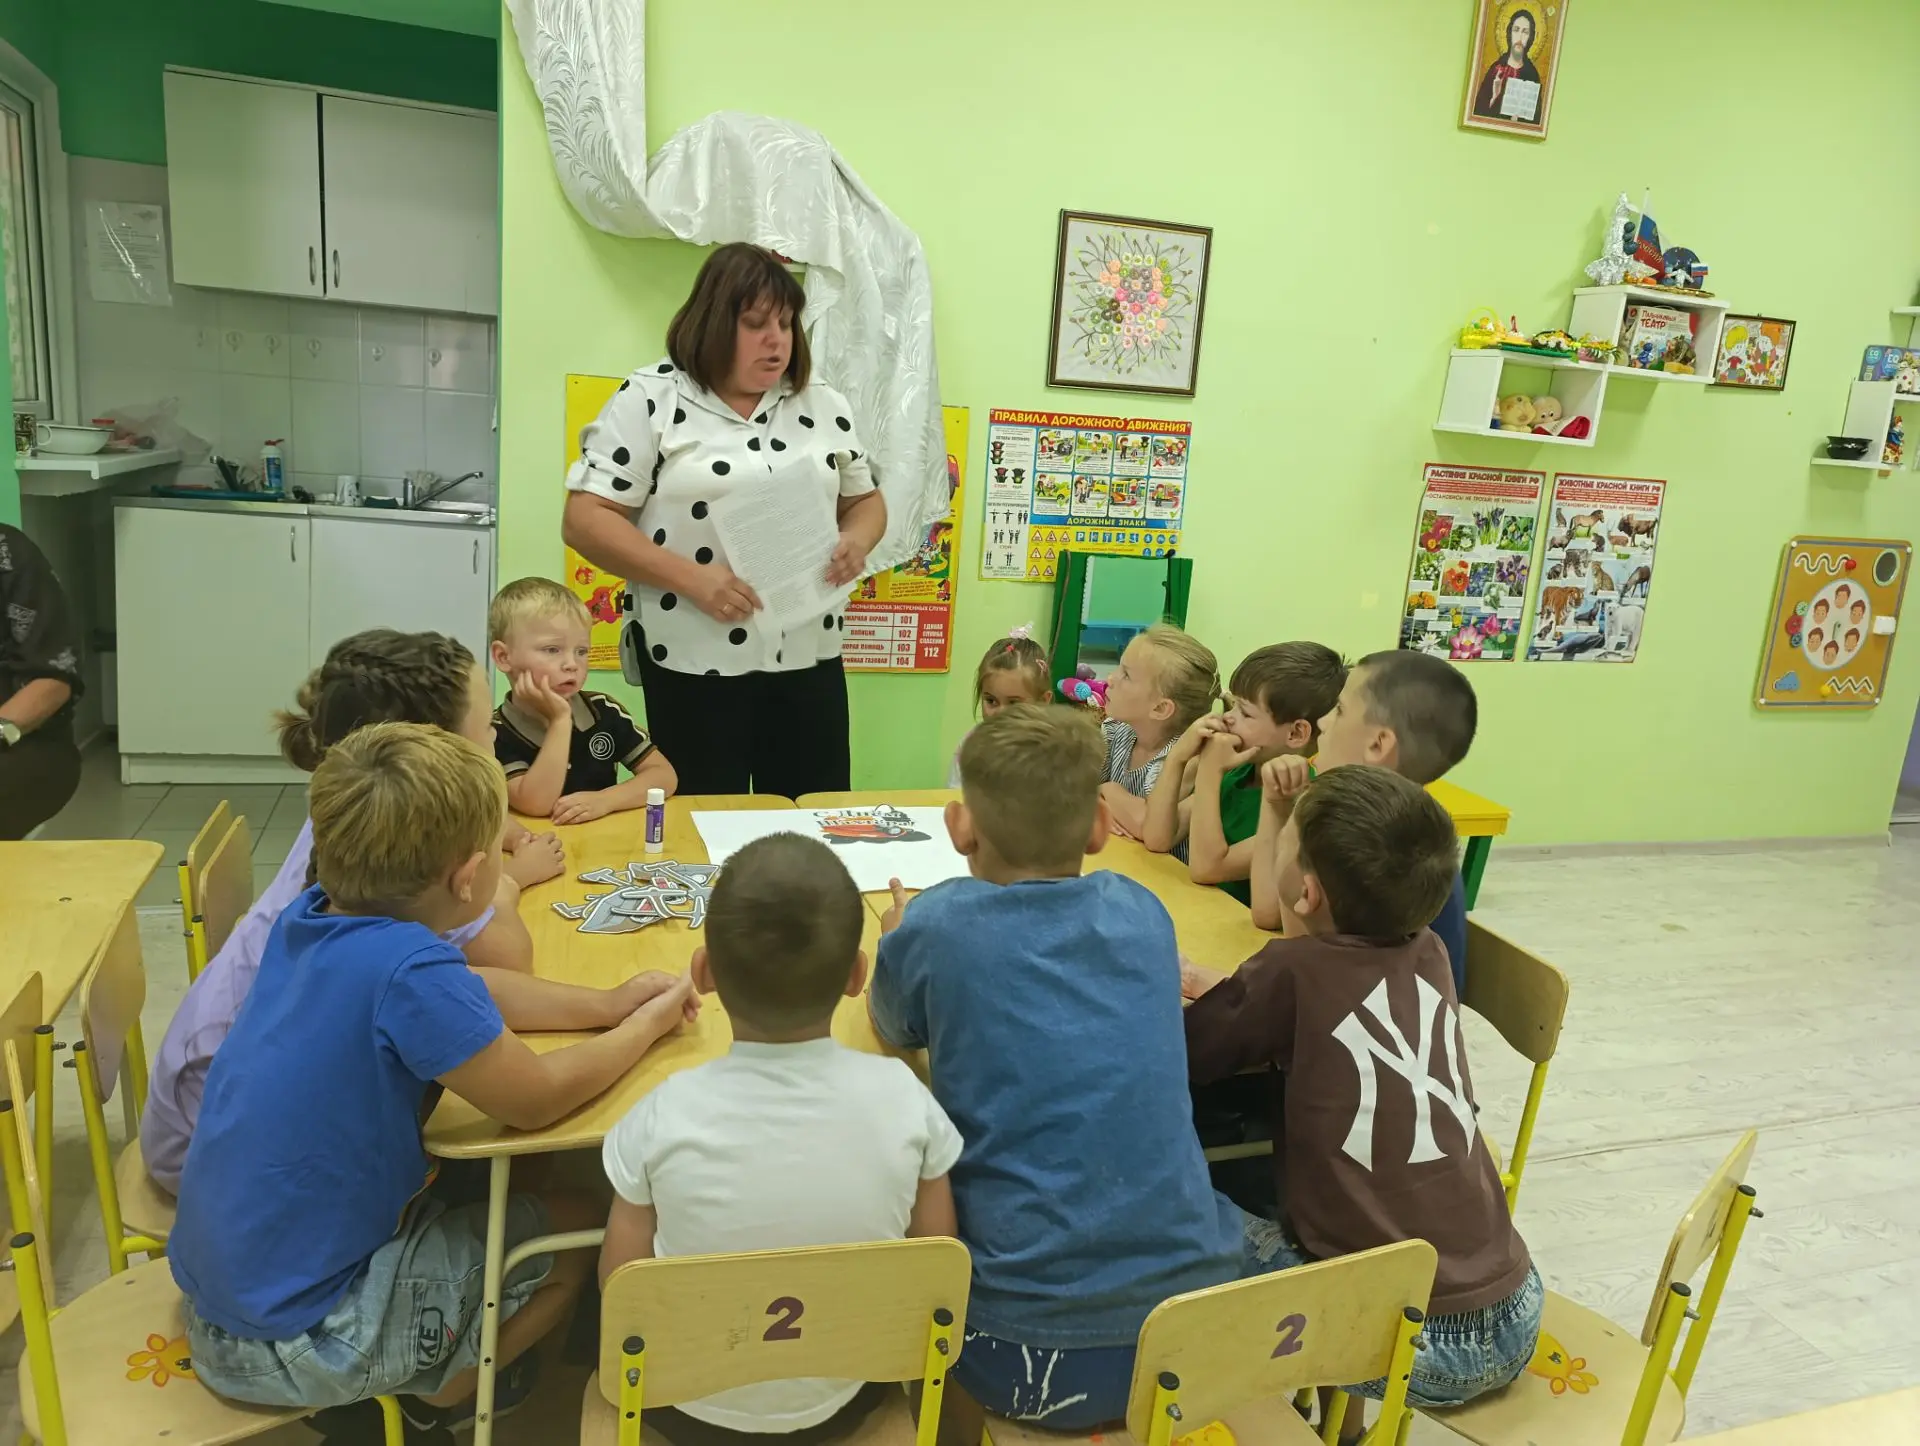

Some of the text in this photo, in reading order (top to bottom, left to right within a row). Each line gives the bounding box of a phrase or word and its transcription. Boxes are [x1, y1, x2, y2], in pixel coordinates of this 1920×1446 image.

[1640, 318, 1666, 330] ТЕАТР
[994, 411, 1187, 432] ПРАВИЛА ДОРОЖНОГО ДВИЖЕНИЯ
[1468, 472, 1502, 482] КРАСНОЙ
[1527, 477, 1540, 485] РФ
[1558, 479, 1661, 493] ЖИВОТНЫЕ КРАСНОЙ КНИГИ РФ
[1067, 517, 1146, 527] ДОРОЖНЫЕ ЗНАКИ
[900, 615, 912, 624] 101
[898, 630, 911, 638] 102
[897, 644, 910, 652] 103
[924, 647, 940, 657] 112
[896, 657, 909, 665] 104
[1331, 973, 1477, 1172] NY
[763, 1296, 804, 1341] 2
[1270, 1313, 1307, 1359] 2
